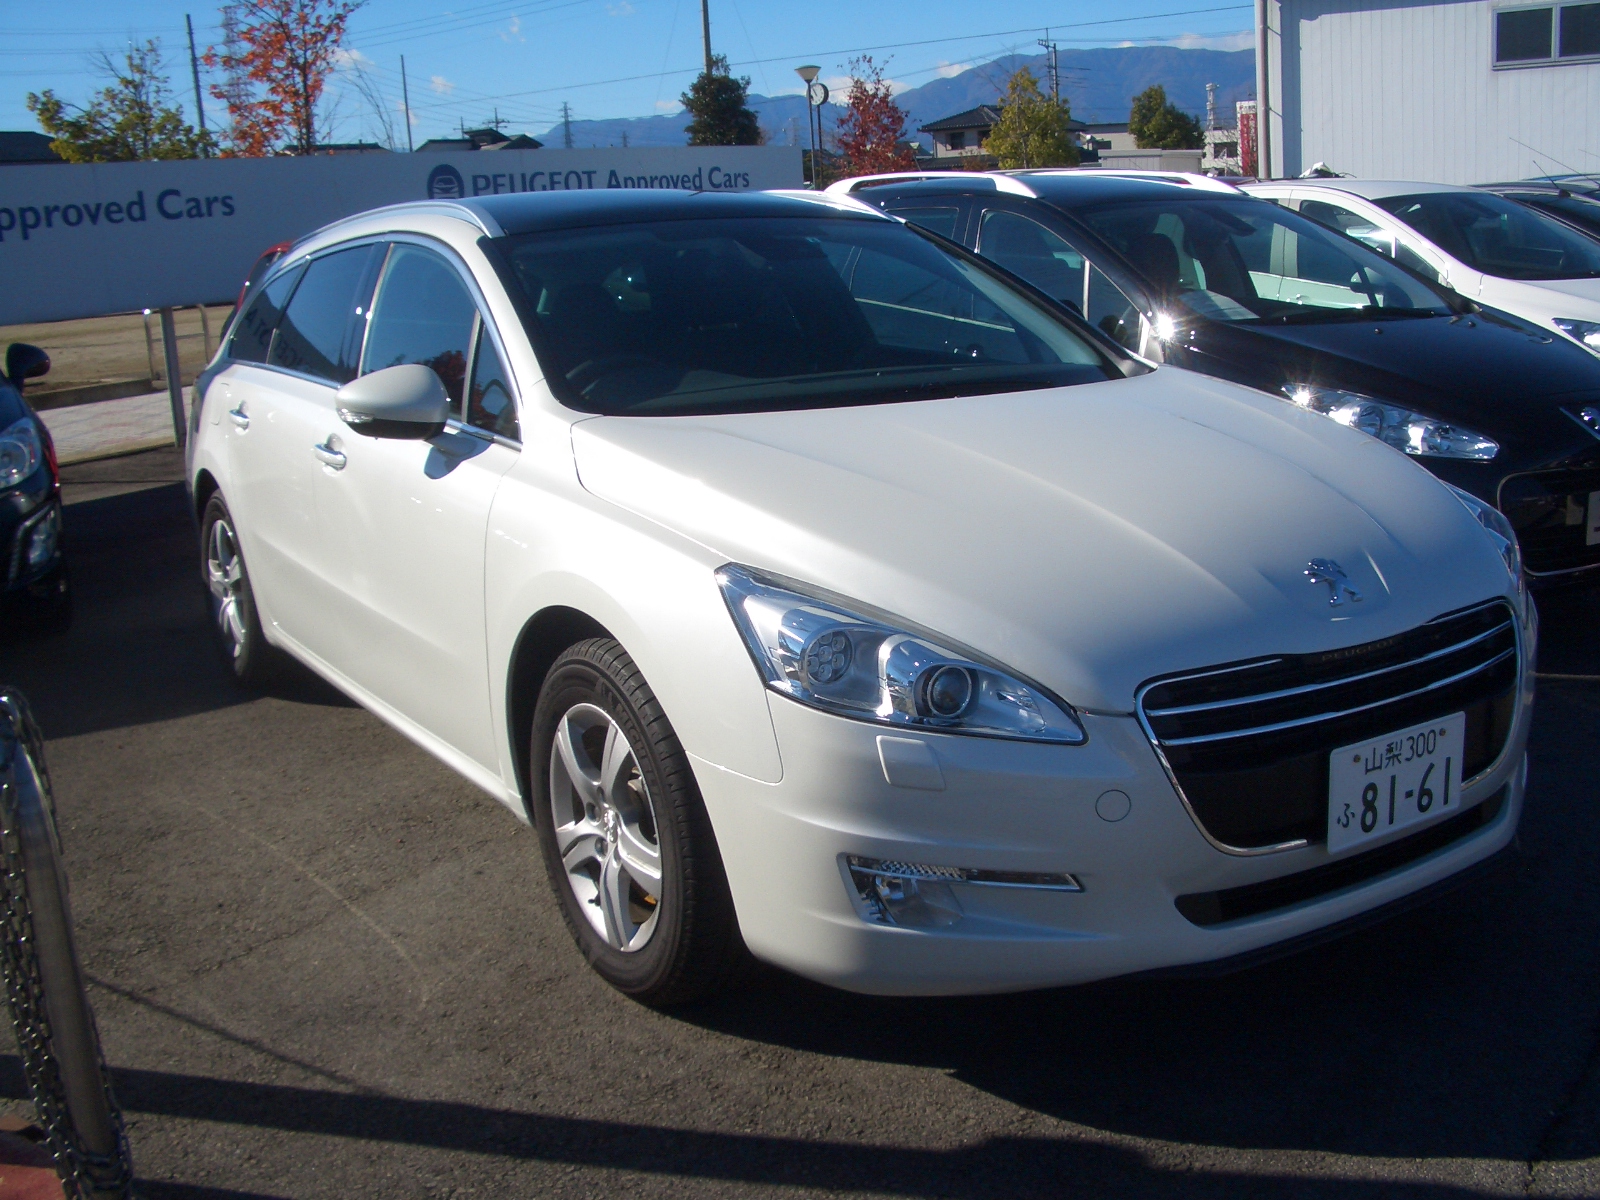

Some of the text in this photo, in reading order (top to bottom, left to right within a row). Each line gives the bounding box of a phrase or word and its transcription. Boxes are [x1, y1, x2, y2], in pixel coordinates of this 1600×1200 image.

[472, 170, 597, 197] PEUGEOT
[708, 166, 750, 189] Cars
[156, 188, 235, 220] Cars
[1336, 756, 1452, 833] ふ 81-61
